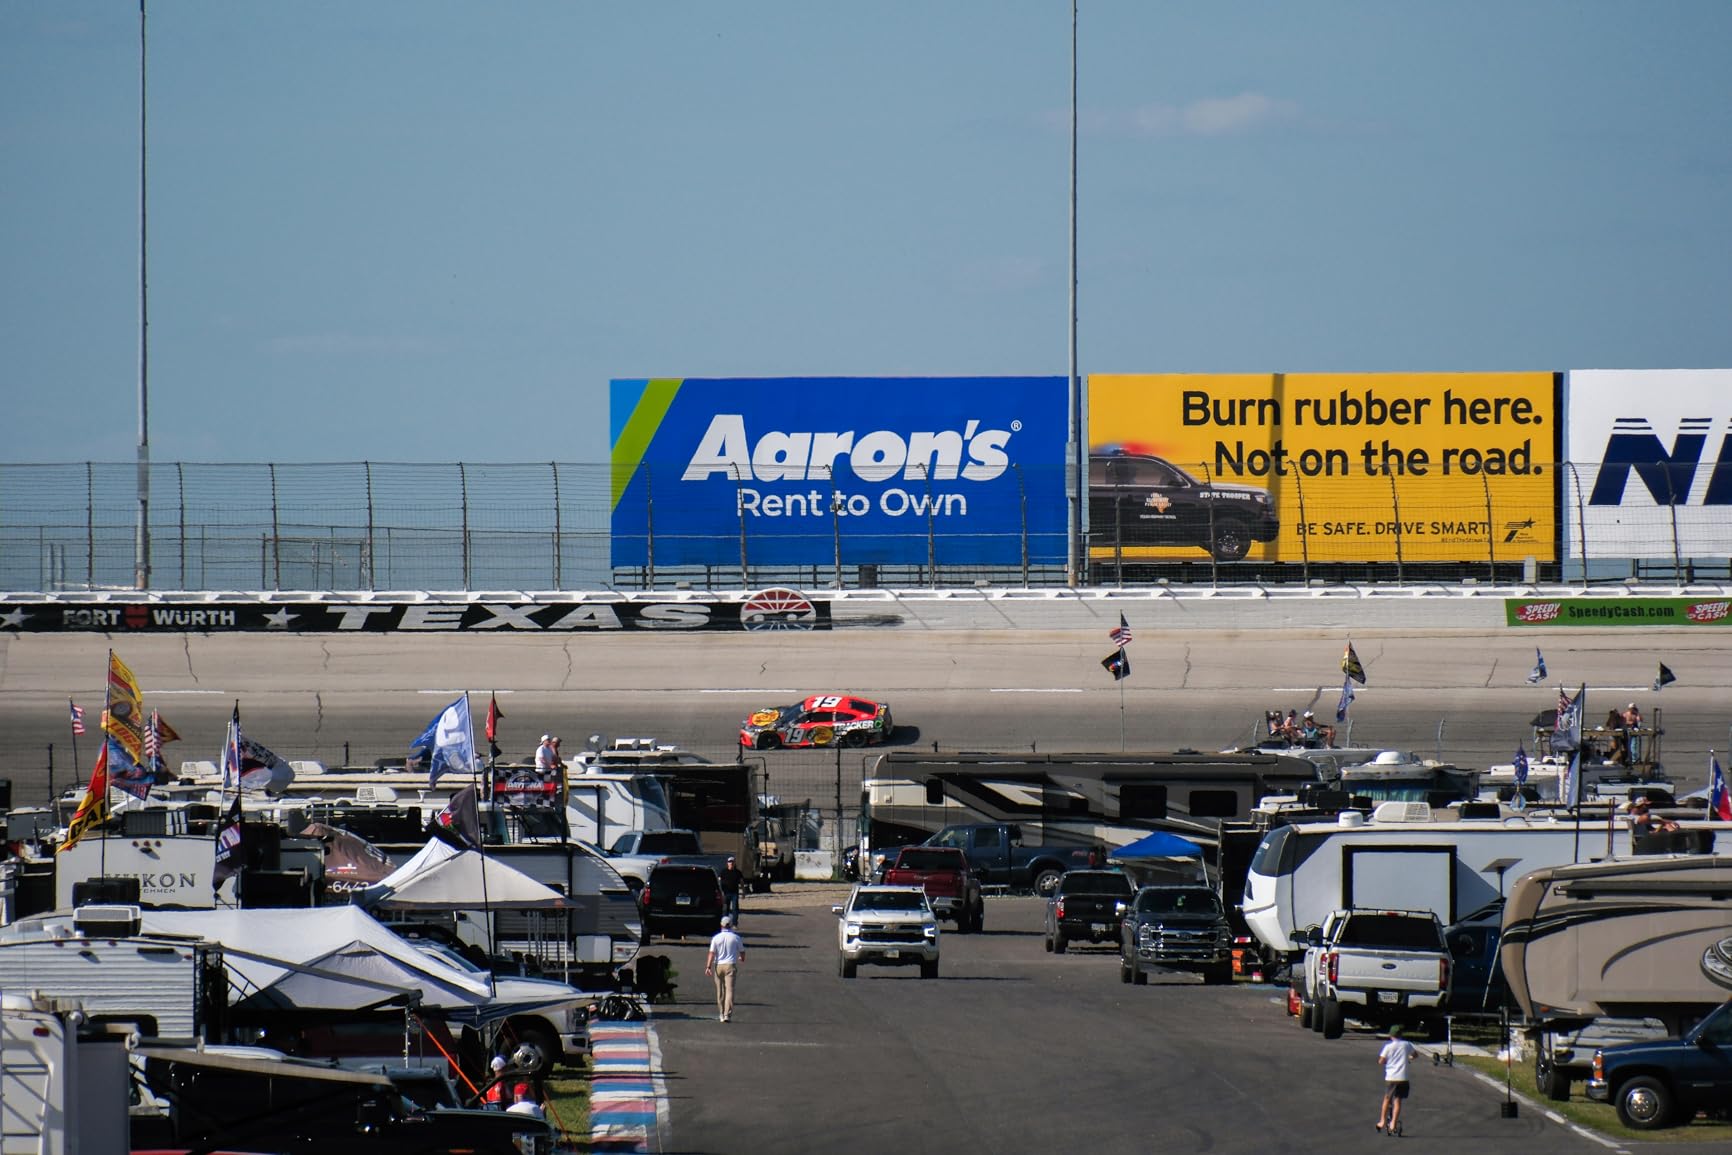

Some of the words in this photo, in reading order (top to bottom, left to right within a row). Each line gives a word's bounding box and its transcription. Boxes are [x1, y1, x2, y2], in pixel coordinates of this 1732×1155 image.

[1182, 390, 1281, 426] Burn
[1295, 389, 1430, 425] rubber
[1444, 389, 1543, 425] here.
[681, 414, 1010, 482] Aaron's
[1215, 440, 1288, 476] Not
[1300, 448, 1349, 476] on
[1360, 440, 1432, 476] the
[1442, 439, 1543, 475] road.
[738, 489, 823, 516] Rent
[835, 491, 870, 516] to
[880, 489, 967, 516] Own
[1296, 522, 1317, 535] BE
[1323, 522, 1371, 535] SAFE.
[1375, 522, 1425, 534] DRIVE
[1525, 603, 1560, 615] SPEEDY
[1568, 604, 1675, 618] SpeedyCash.com
[1695, 602, 1730, 614] SPEEDY
[63, 609, 121, 626] FORT
[326, 604, 711, 630] TEXAS
[1527, 611, 1558, 621] CASH
[1697, 611, 1728, 620] CASH
[811, 696, 843, 708] 19
[833, 720, 874, 732] TRACKER
[783, 728, 805, 743] 19
[104, 873, 196, 888] KON
